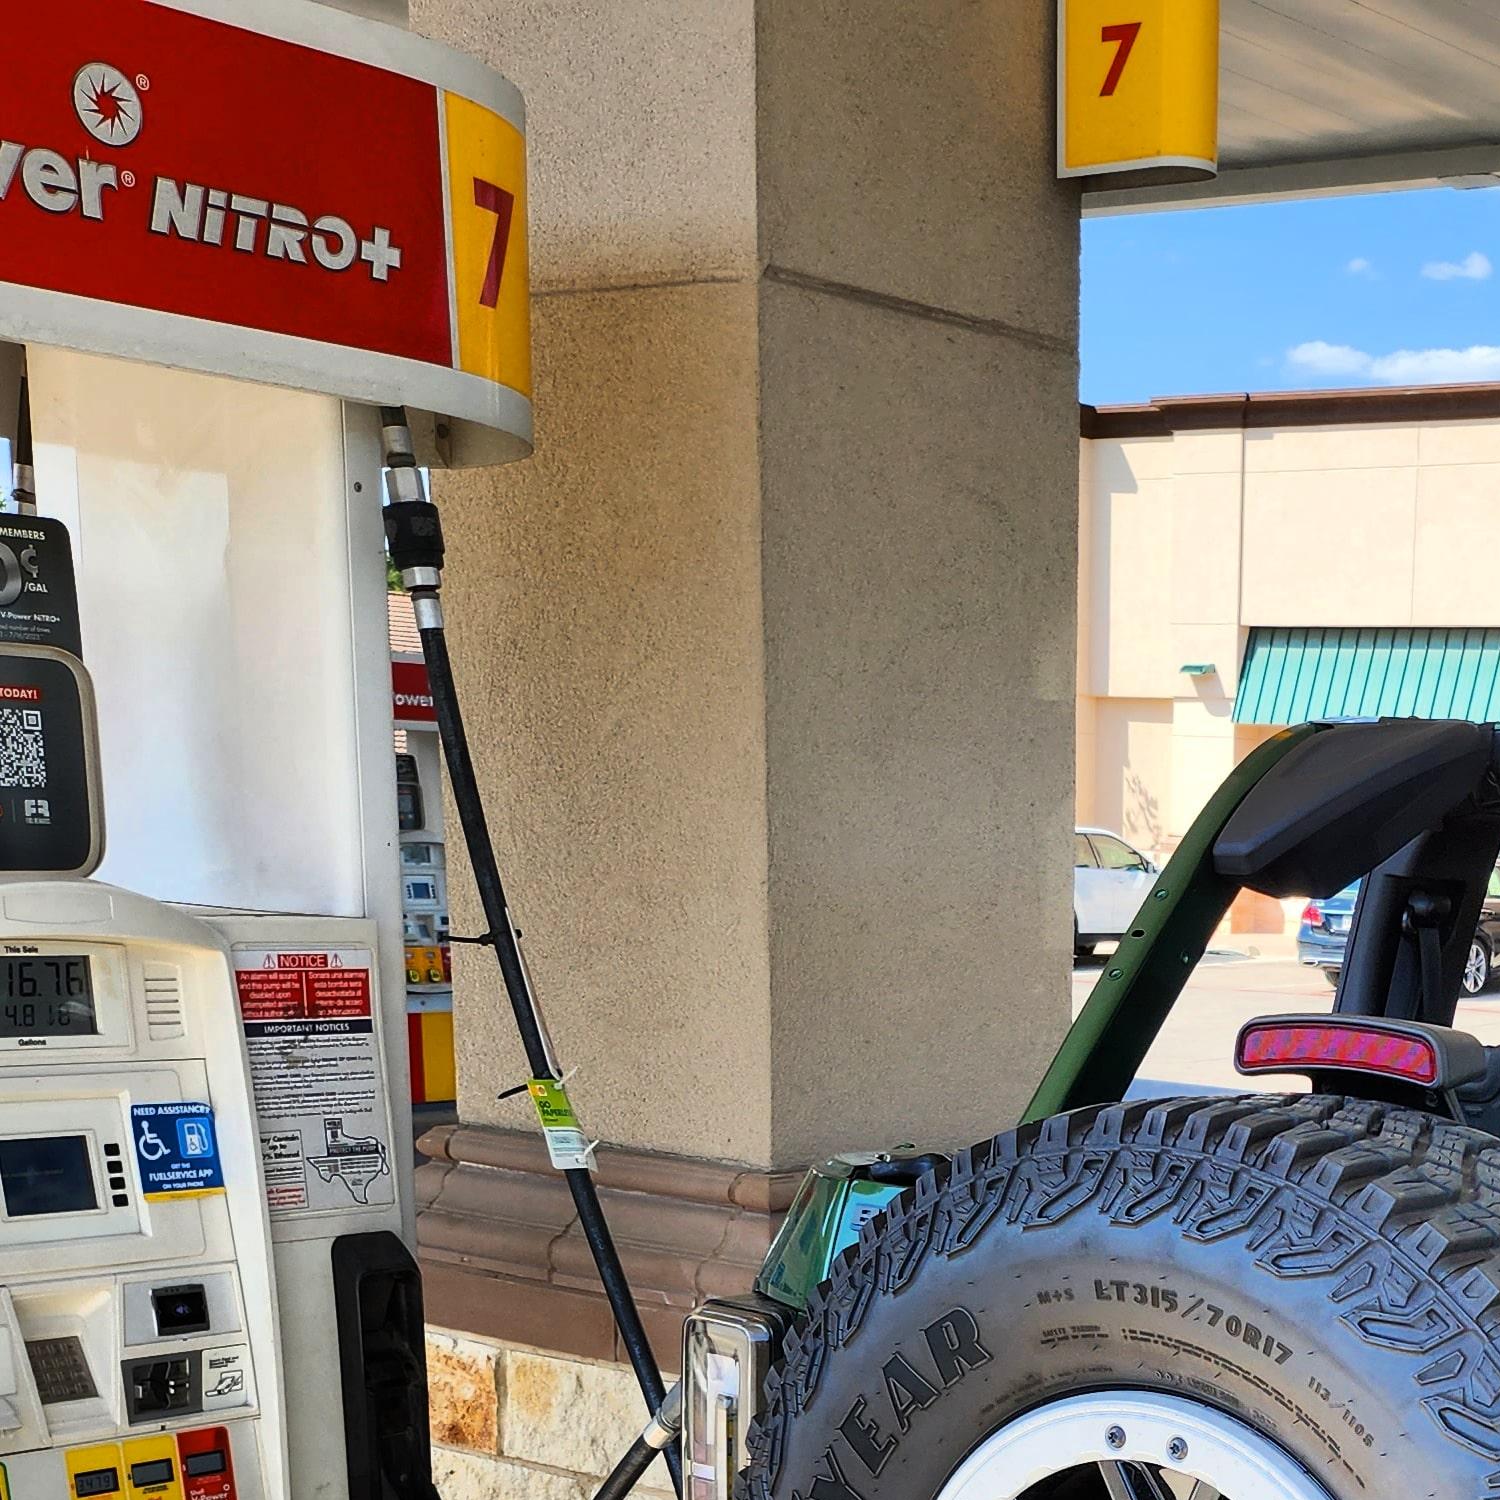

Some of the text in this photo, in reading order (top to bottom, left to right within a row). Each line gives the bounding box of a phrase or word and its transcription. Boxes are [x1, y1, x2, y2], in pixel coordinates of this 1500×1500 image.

[1099, 22, 1142, 97] 7
[473, 176, 515, 309] 7
[4, 945, 21, 954] This
[279, 955, 326, 968] NOTICE
[264, 1023, 350, 1034] IMPORTANT NOTICES
